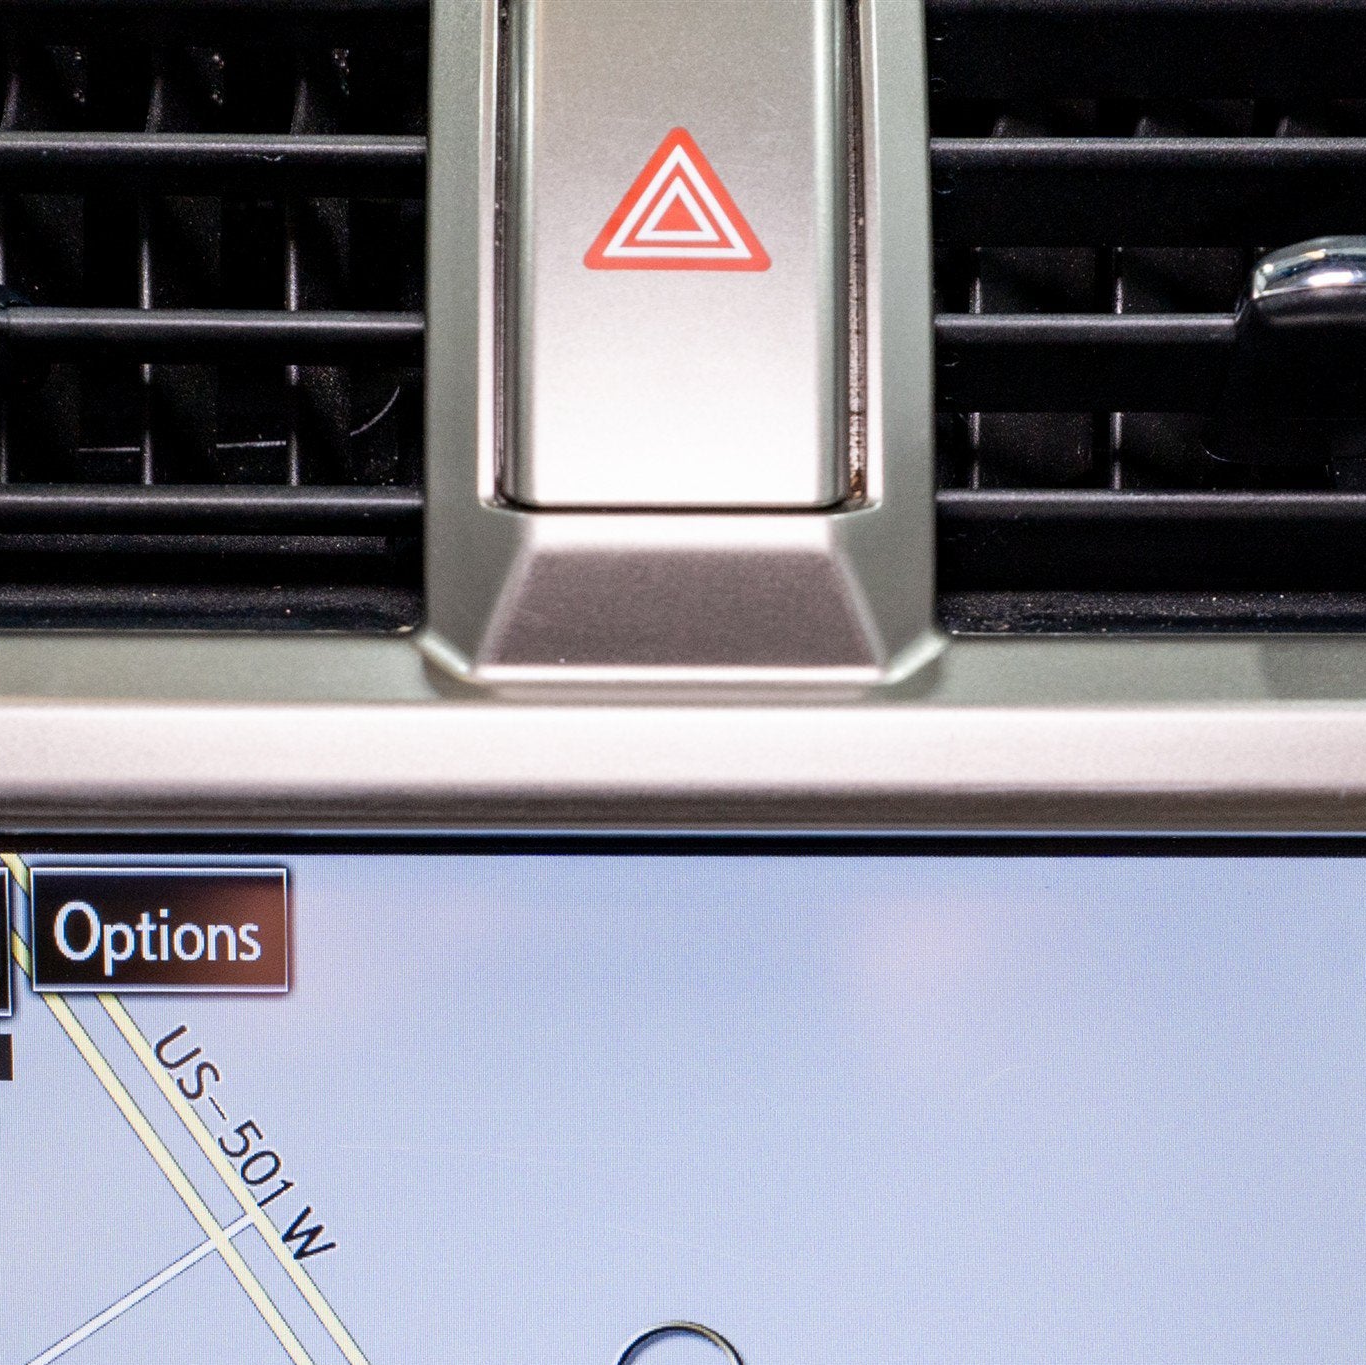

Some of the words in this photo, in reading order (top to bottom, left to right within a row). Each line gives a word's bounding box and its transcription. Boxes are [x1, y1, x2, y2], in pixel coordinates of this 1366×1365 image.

[54, 902, 261, 975] Options
[154, 1026, 295, 1208] US-501
[281, 1207, 336, 1260] W
